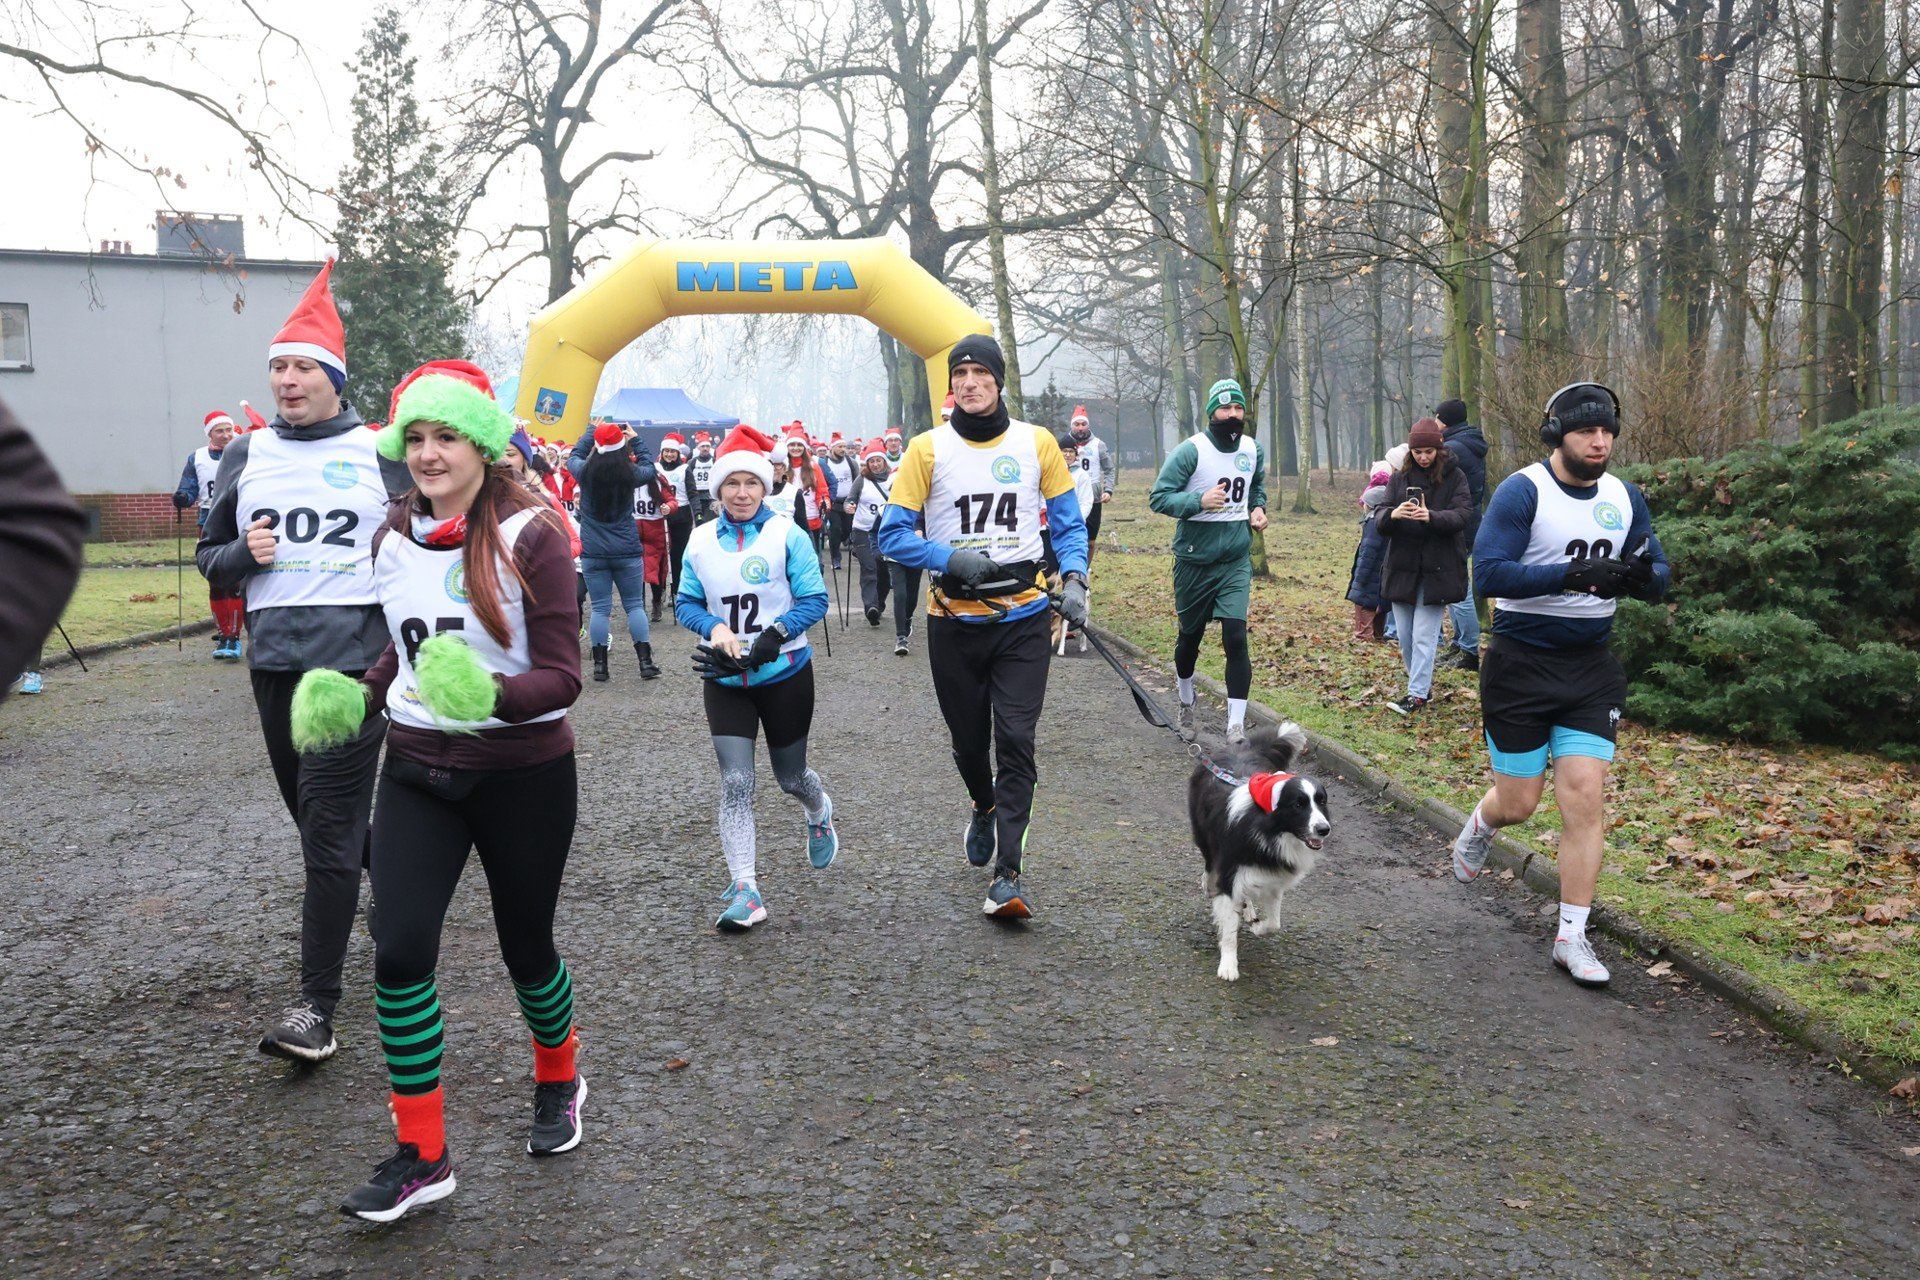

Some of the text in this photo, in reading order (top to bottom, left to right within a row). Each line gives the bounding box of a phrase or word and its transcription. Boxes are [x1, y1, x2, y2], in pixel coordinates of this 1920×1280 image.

[677, 261, 858, 292] META
[697, 472, 709, 482] 59
[1217, 477, 1245, 503] 28
[636, 500, 656, 515] 89
[954, 493, 1018, 534] 174
[251, 507, 359, 548] 202
[721, 593, 762, 634] 72
